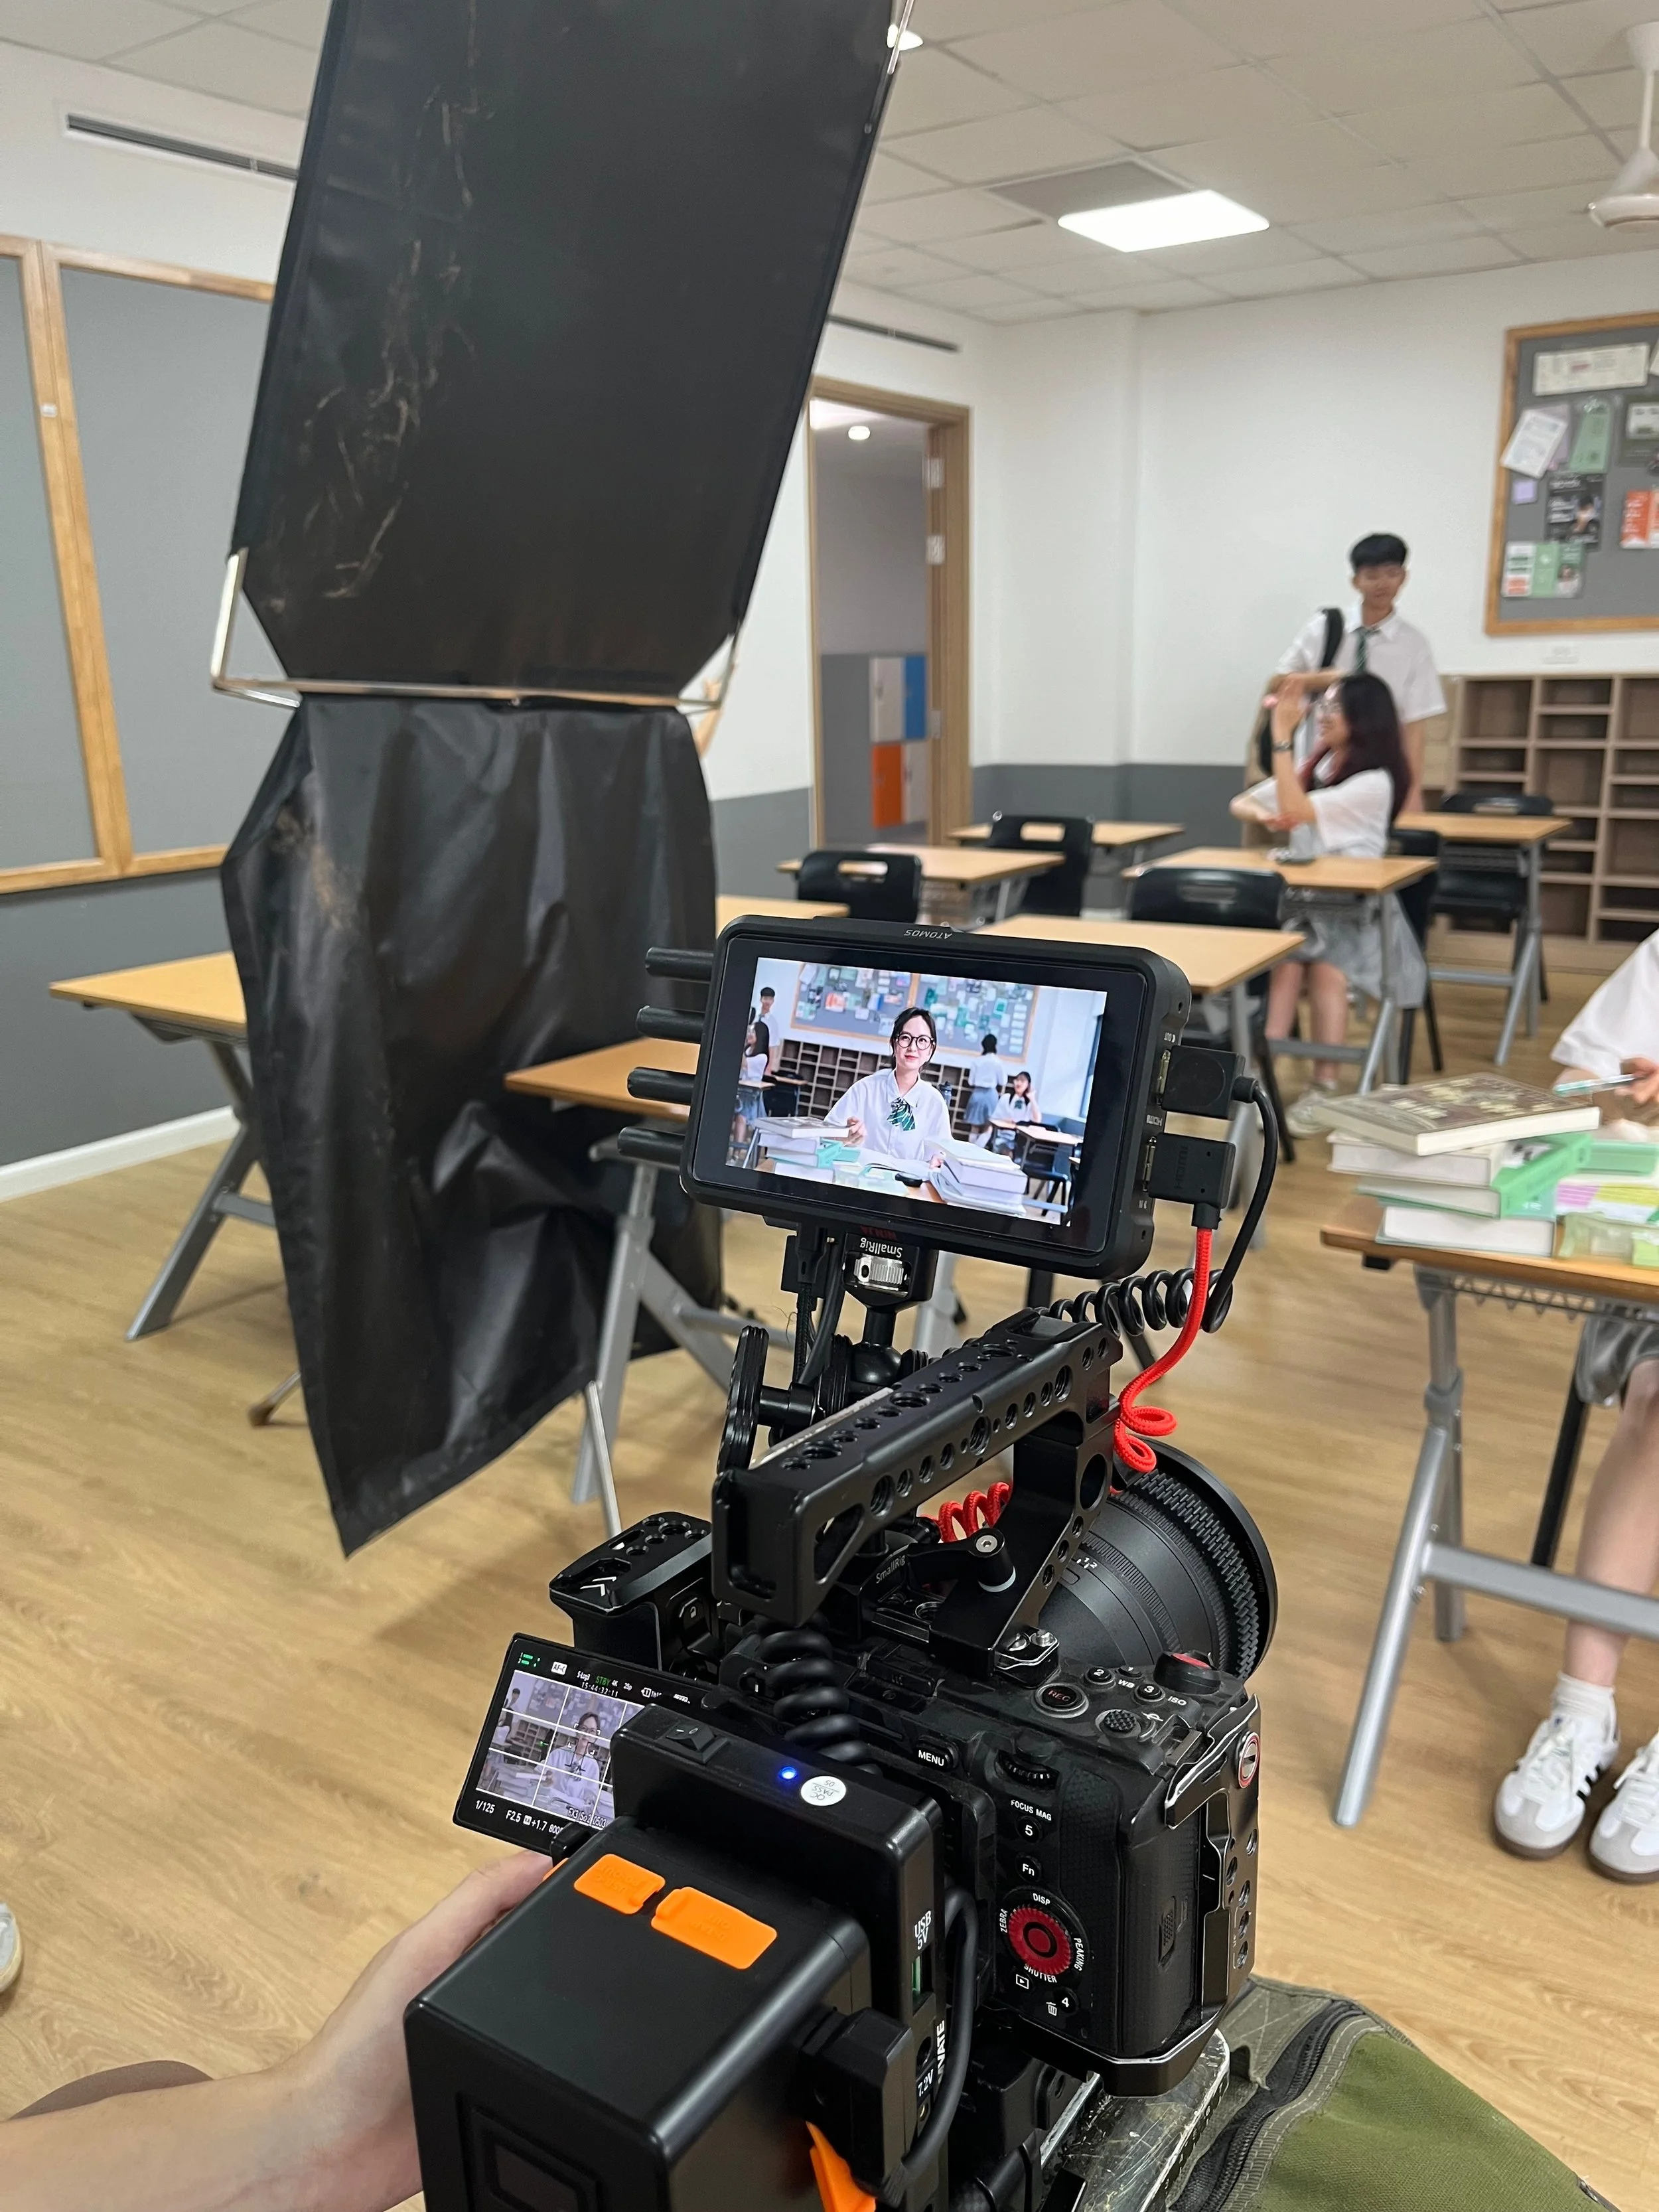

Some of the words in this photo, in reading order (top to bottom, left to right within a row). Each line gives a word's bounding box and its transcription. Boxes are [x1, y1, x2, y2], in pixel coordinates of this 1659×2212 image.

[903, 929, 953, 940] ATOMOS
[859, 1237, 903, 1258] SmallRig
[875, 1554, 906, 1584] SmallRig
[595, 1675, 612, 1687] STBY
[1118, 1678, 1135, 1689] WB
[1047, 1688, 1071, 1703] REC
[1167, 1696, 1187, 1706] ISO
[917, 1749, 945, 1767] MENU
[812, 1785, 834, 1797] PASS
[474, 1800, 496, 1814] 1/125
[505, 1809, 522, 1822] F2.5
[1011, 1799, 1034, 1814] FOCUS
[1036, 1808, 1052, 1821] MAG
[1025, 1824, 1033, 1836] 5
[1022, 1863, 1035, 1876] Fn
[1033, 1893, 1050, 1906] DISP
[914, 1910, 932, 1939] USB
[999, 1909, 1009, 1933] ZEBRA
[917, 1927, 929, 1951] 5V
[1073, 1937, 1085, 1972] PEAKING
[1023, 1964, 1057, 1984] SHUTTER
[1061, 1997, 1070, 2008] 4
[918, 2068, 934, 2098] 7.2V
